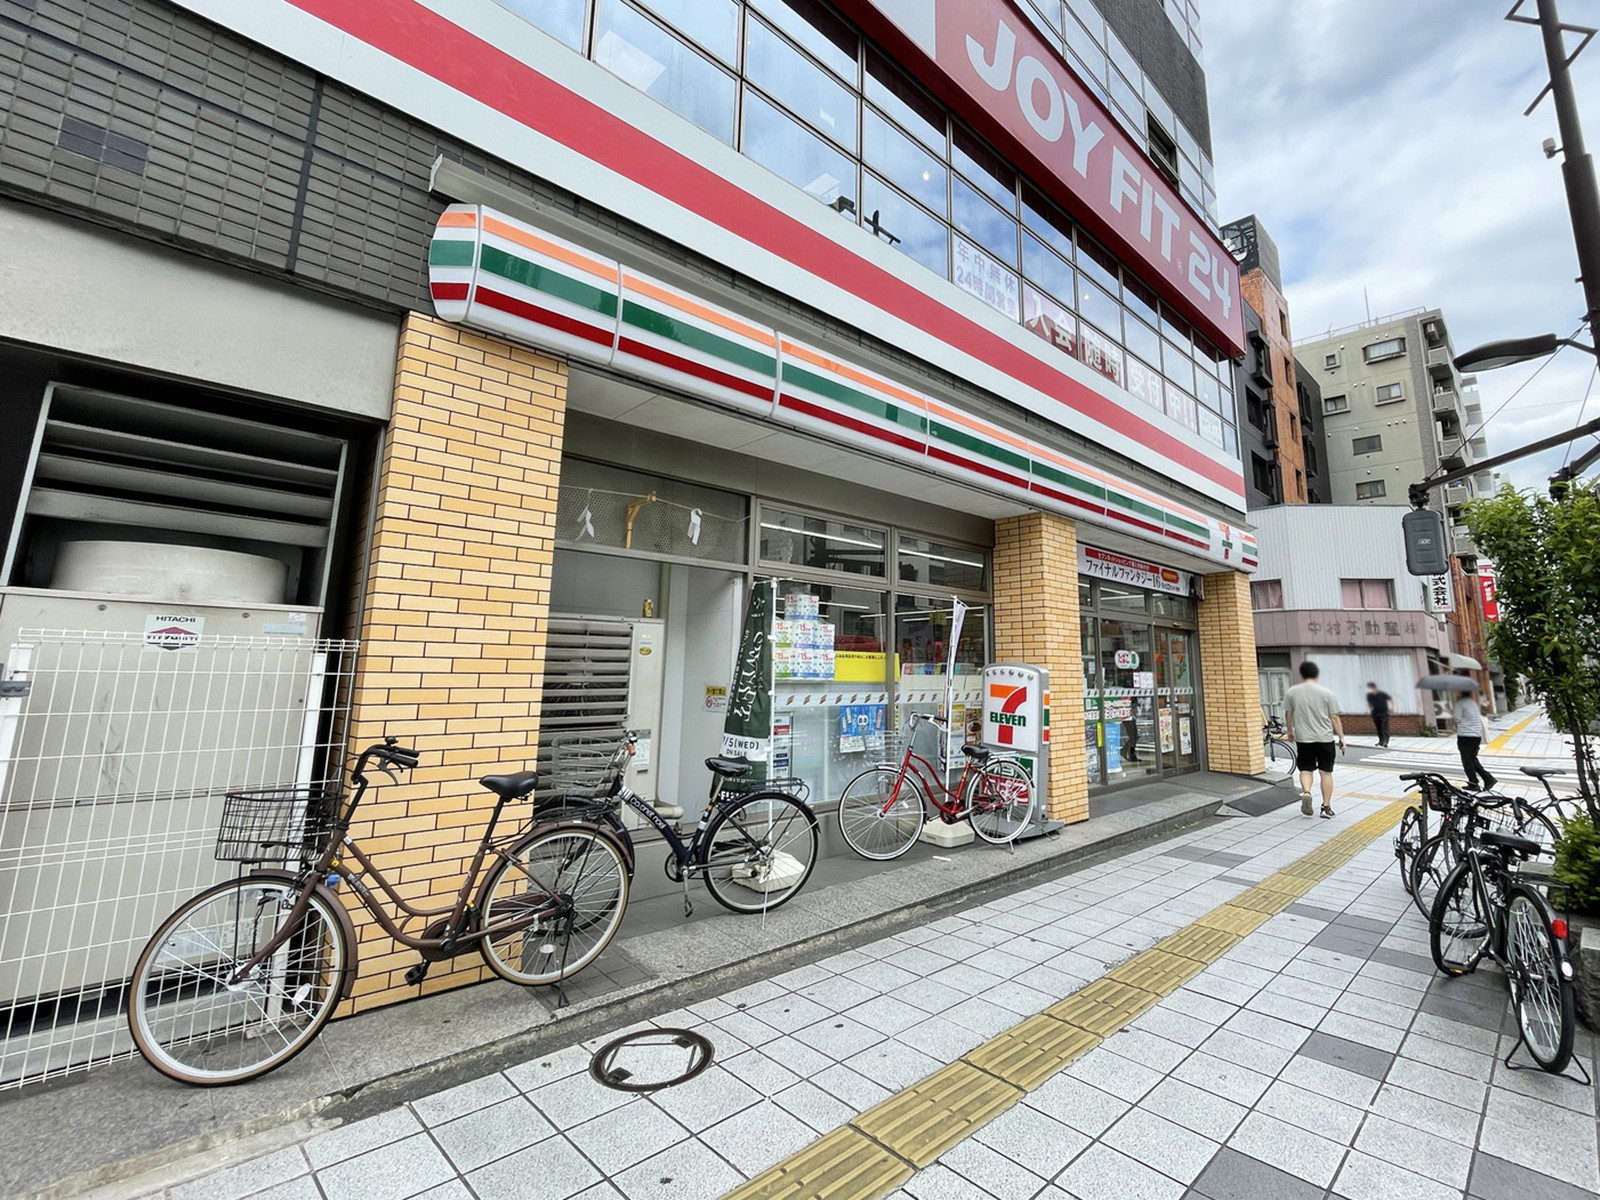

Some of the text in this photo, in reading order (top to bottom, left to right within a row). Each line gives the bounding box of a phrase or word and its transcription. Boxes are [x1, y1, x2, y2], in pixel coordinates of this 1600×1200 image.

[966, 18, 1231, 320] JOY FIT 24
[957, 241, 1015, 293] 年中無休
[957, 265, 1017, 317] 24時間営業
[1086, 559, 1160, 589] ファイナルファンタジー16
